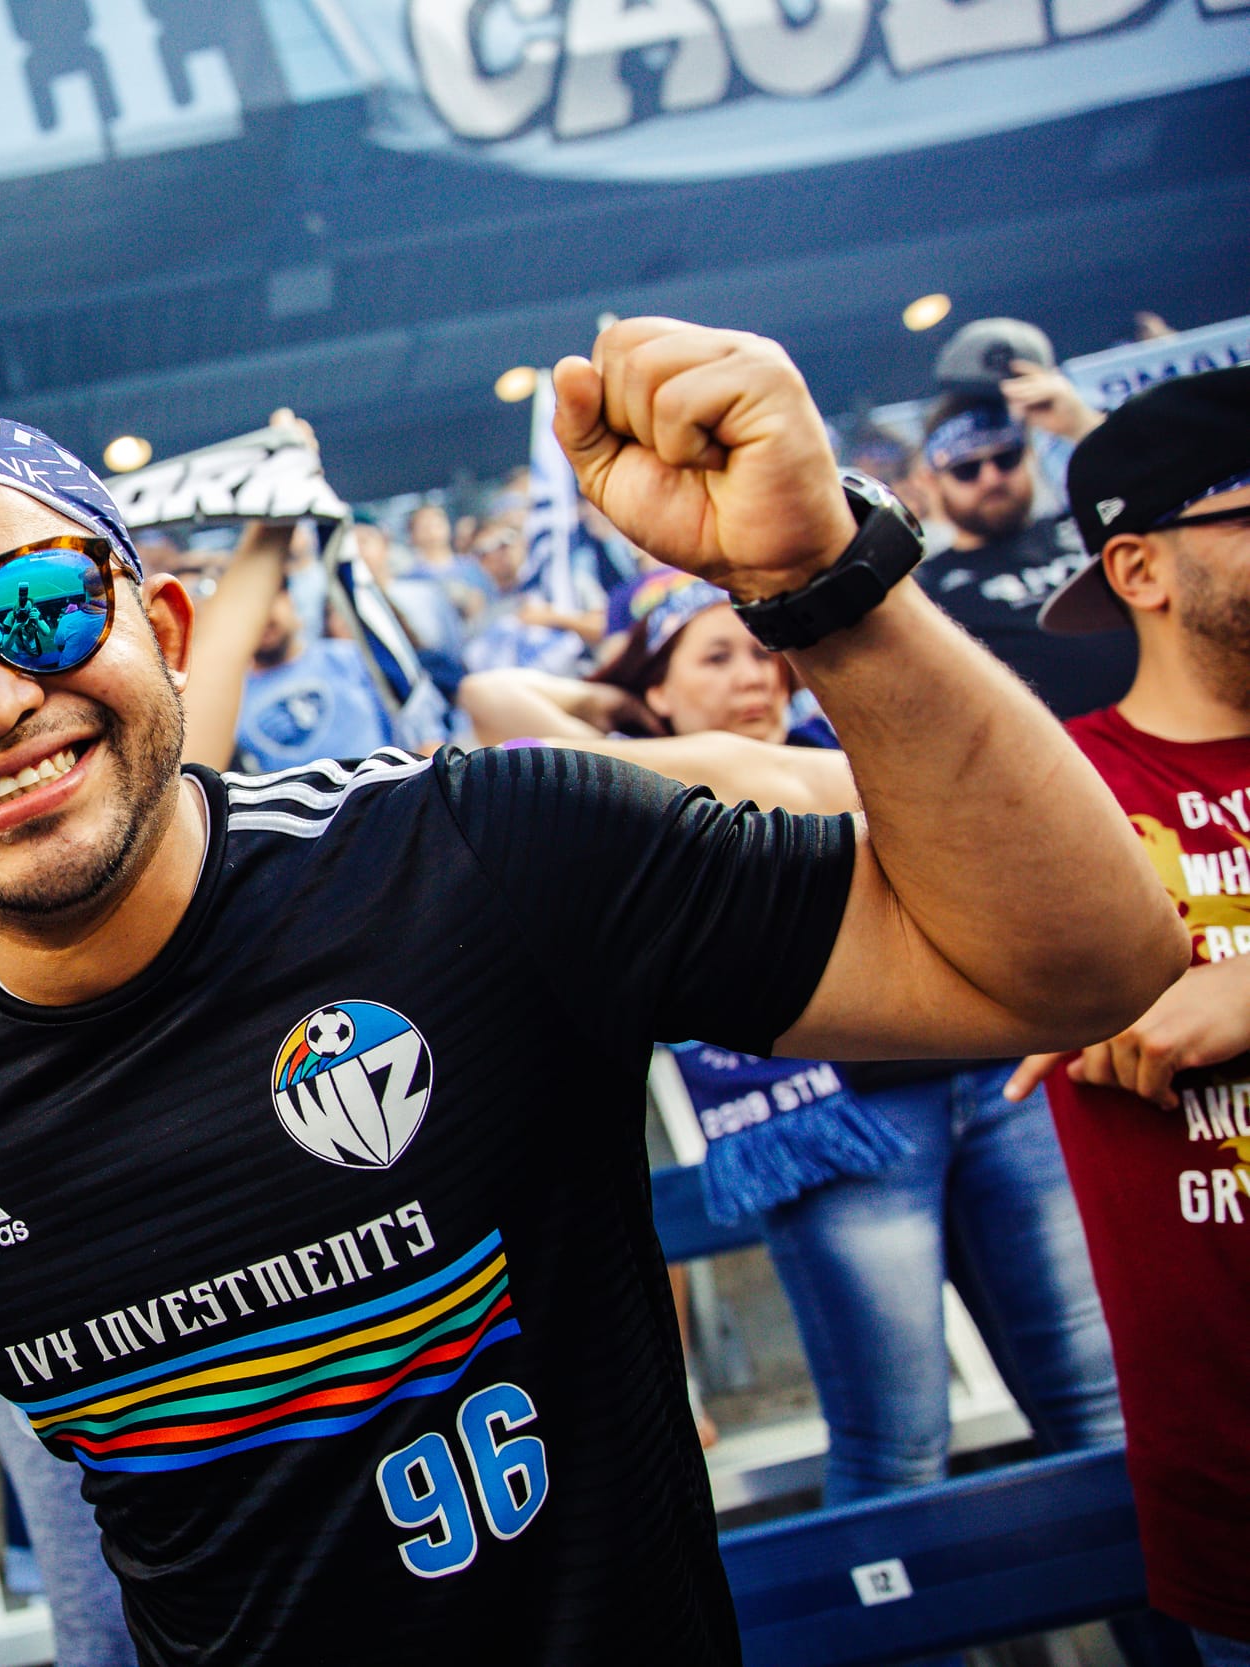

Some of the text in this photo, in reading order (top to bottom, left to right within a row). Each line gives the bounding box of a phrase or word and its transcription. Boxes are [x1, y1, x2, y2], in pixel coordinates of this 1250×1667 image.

[1179, 846, 1250, 896] WH
[273, 1028, 430, 1168] WIZ
[4, 1200, 436, 1387] IVY INVESTMENTS
[376, 1382, 549, 1579] 96
